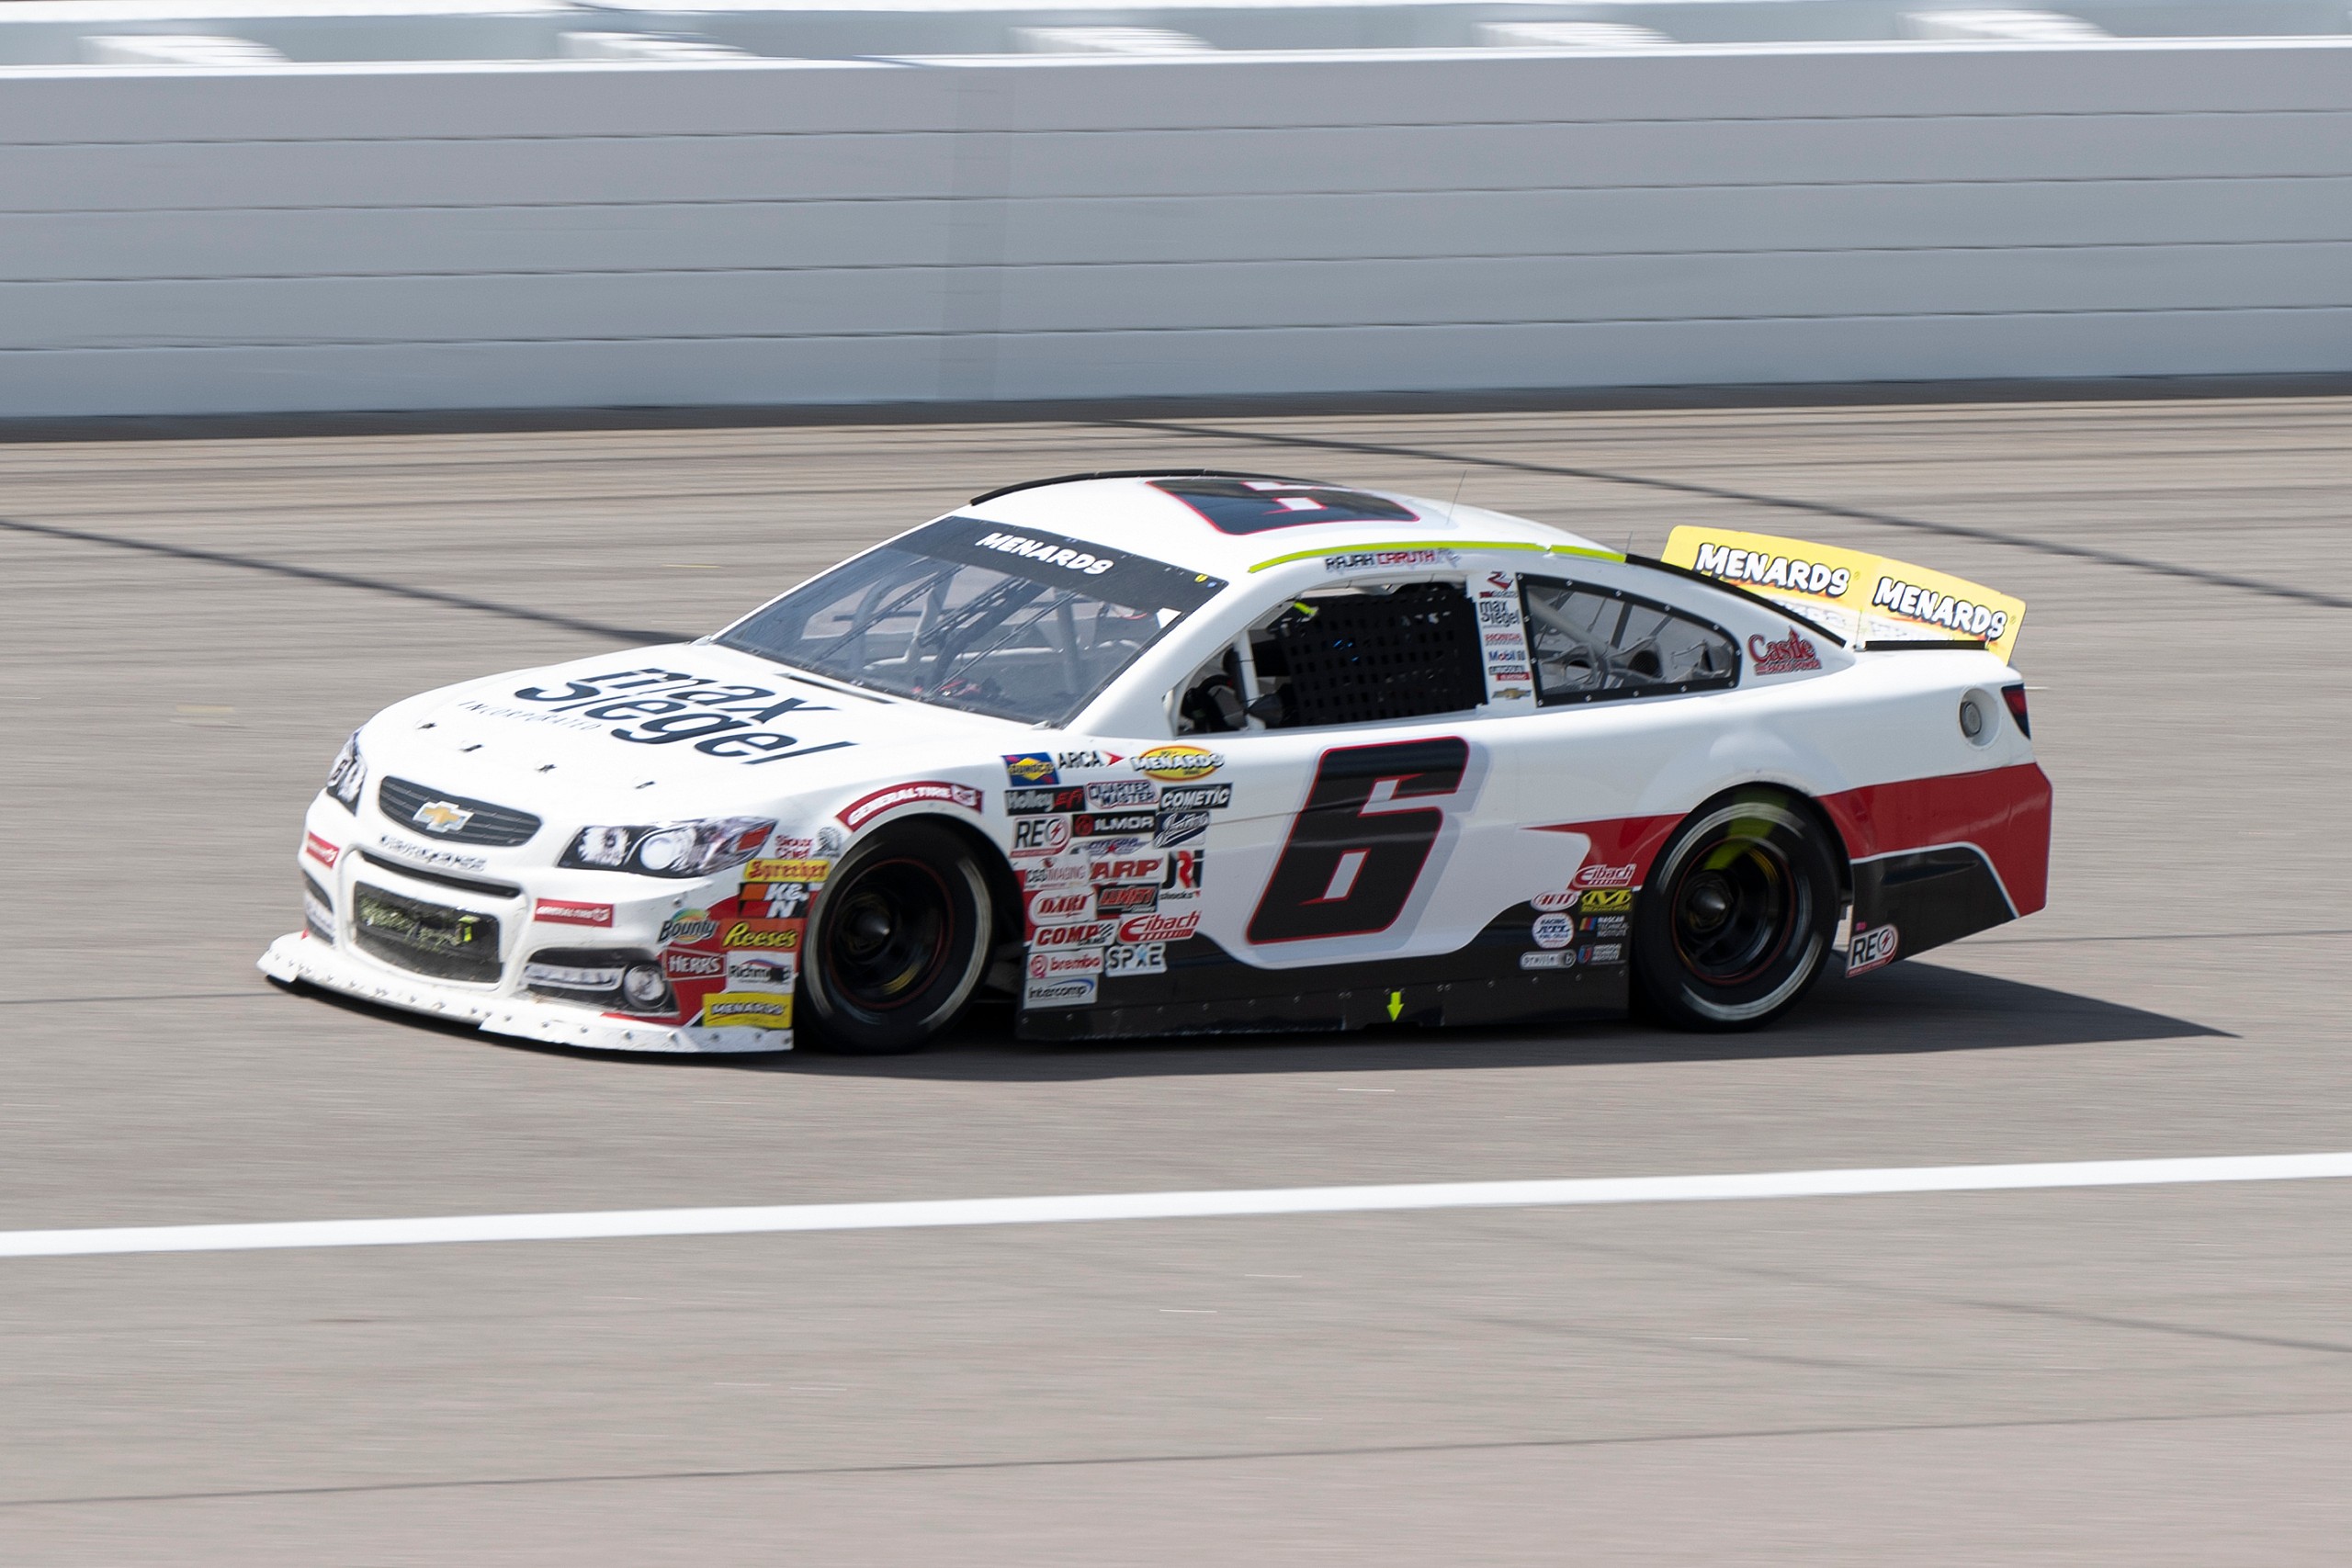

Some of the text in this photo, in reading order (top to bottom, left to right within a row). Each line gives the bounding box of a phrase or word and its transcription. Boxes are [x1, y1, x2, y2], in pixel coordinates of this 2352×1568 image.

[975, 532, 1115, 577] MENARDS
[1325, 553, 1375, 570] RAJAH
[1694, 542, 1852, 597] MENARDS
[1479, 601, 1507, 613] max
[1872, 576, 2007, 641] MENARDS
[1748, 626, 1817, 665] Castle
[577, 668, 842, 724] max
[1057, 750, 1103, 769] ARCA
[1130, 752, 1225, 772] MENARDS
[1006, 790, 1055, 812] Holley
[1161, 786, 1230, 808] COMETIC
[1246, 735, 1469, 945] 6
[1089, 858, 1163, 879] ARP
[1572, 863, 1637, 887] Eibach
[657, 919, 719, 943] Bounty
[1036, 924, 1100, 946] COMP
[1119, 909, 1202, 942] Eibach
[1051, 953, 1101, 971] brembo
